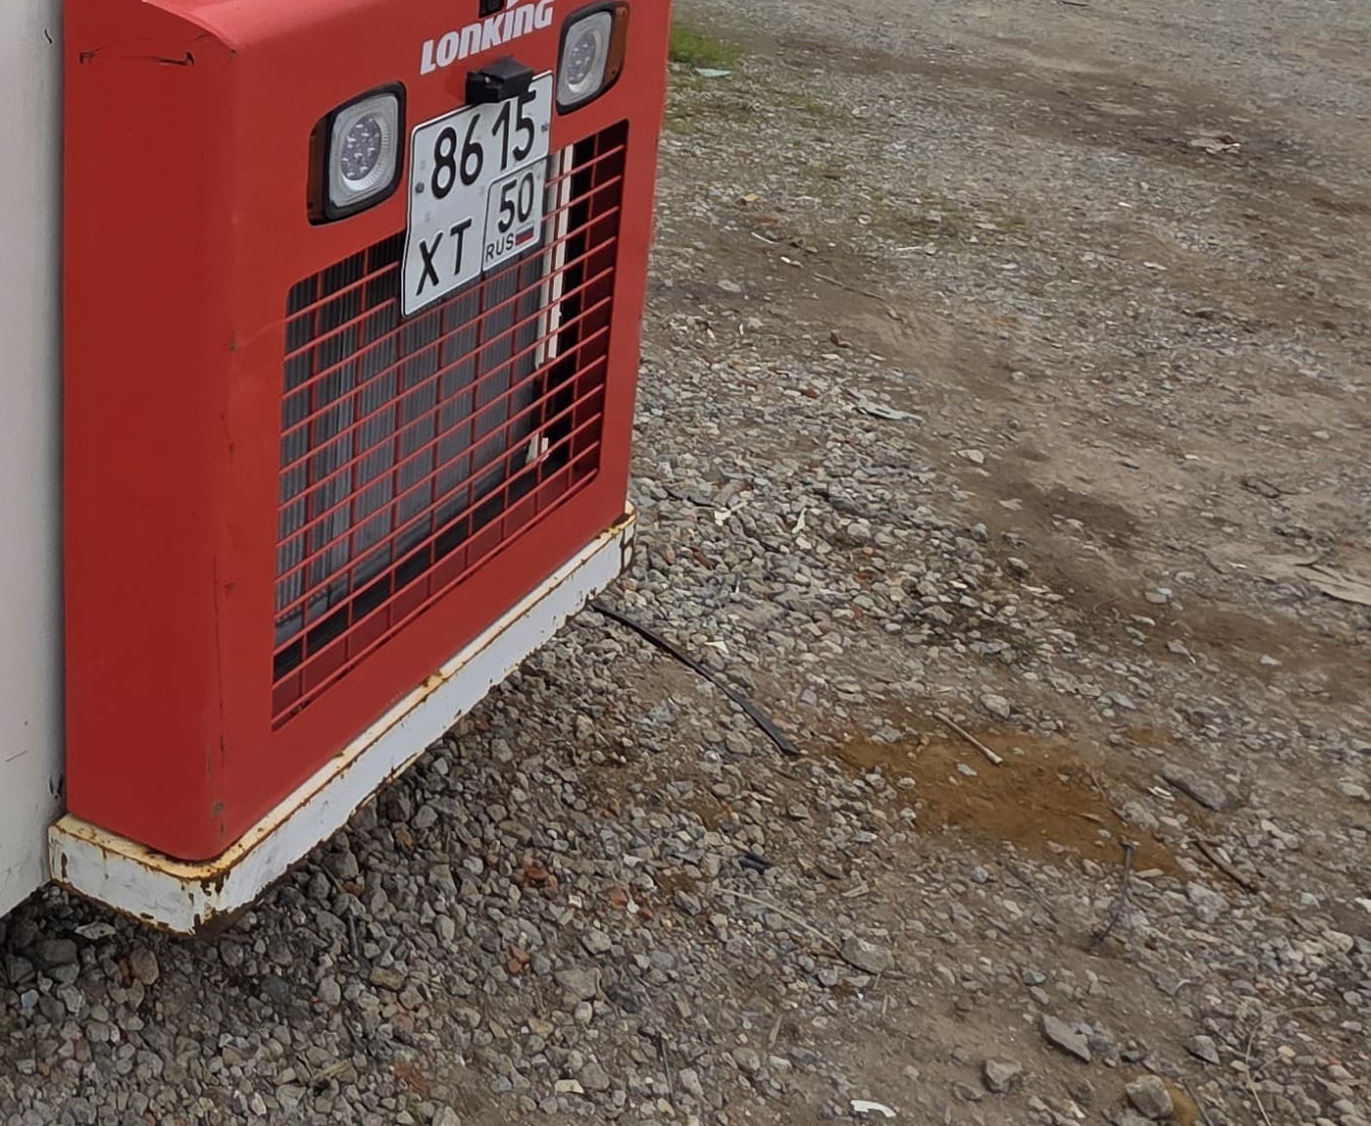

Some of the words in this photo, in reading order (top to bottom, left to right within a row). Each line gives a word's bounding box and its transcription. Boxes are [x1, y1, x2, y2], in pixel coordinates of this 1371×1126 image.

[431, 89, 537, 200] 8615
[497, 171, 535, 234] 50
[485, 233, 516, 261] RUS
